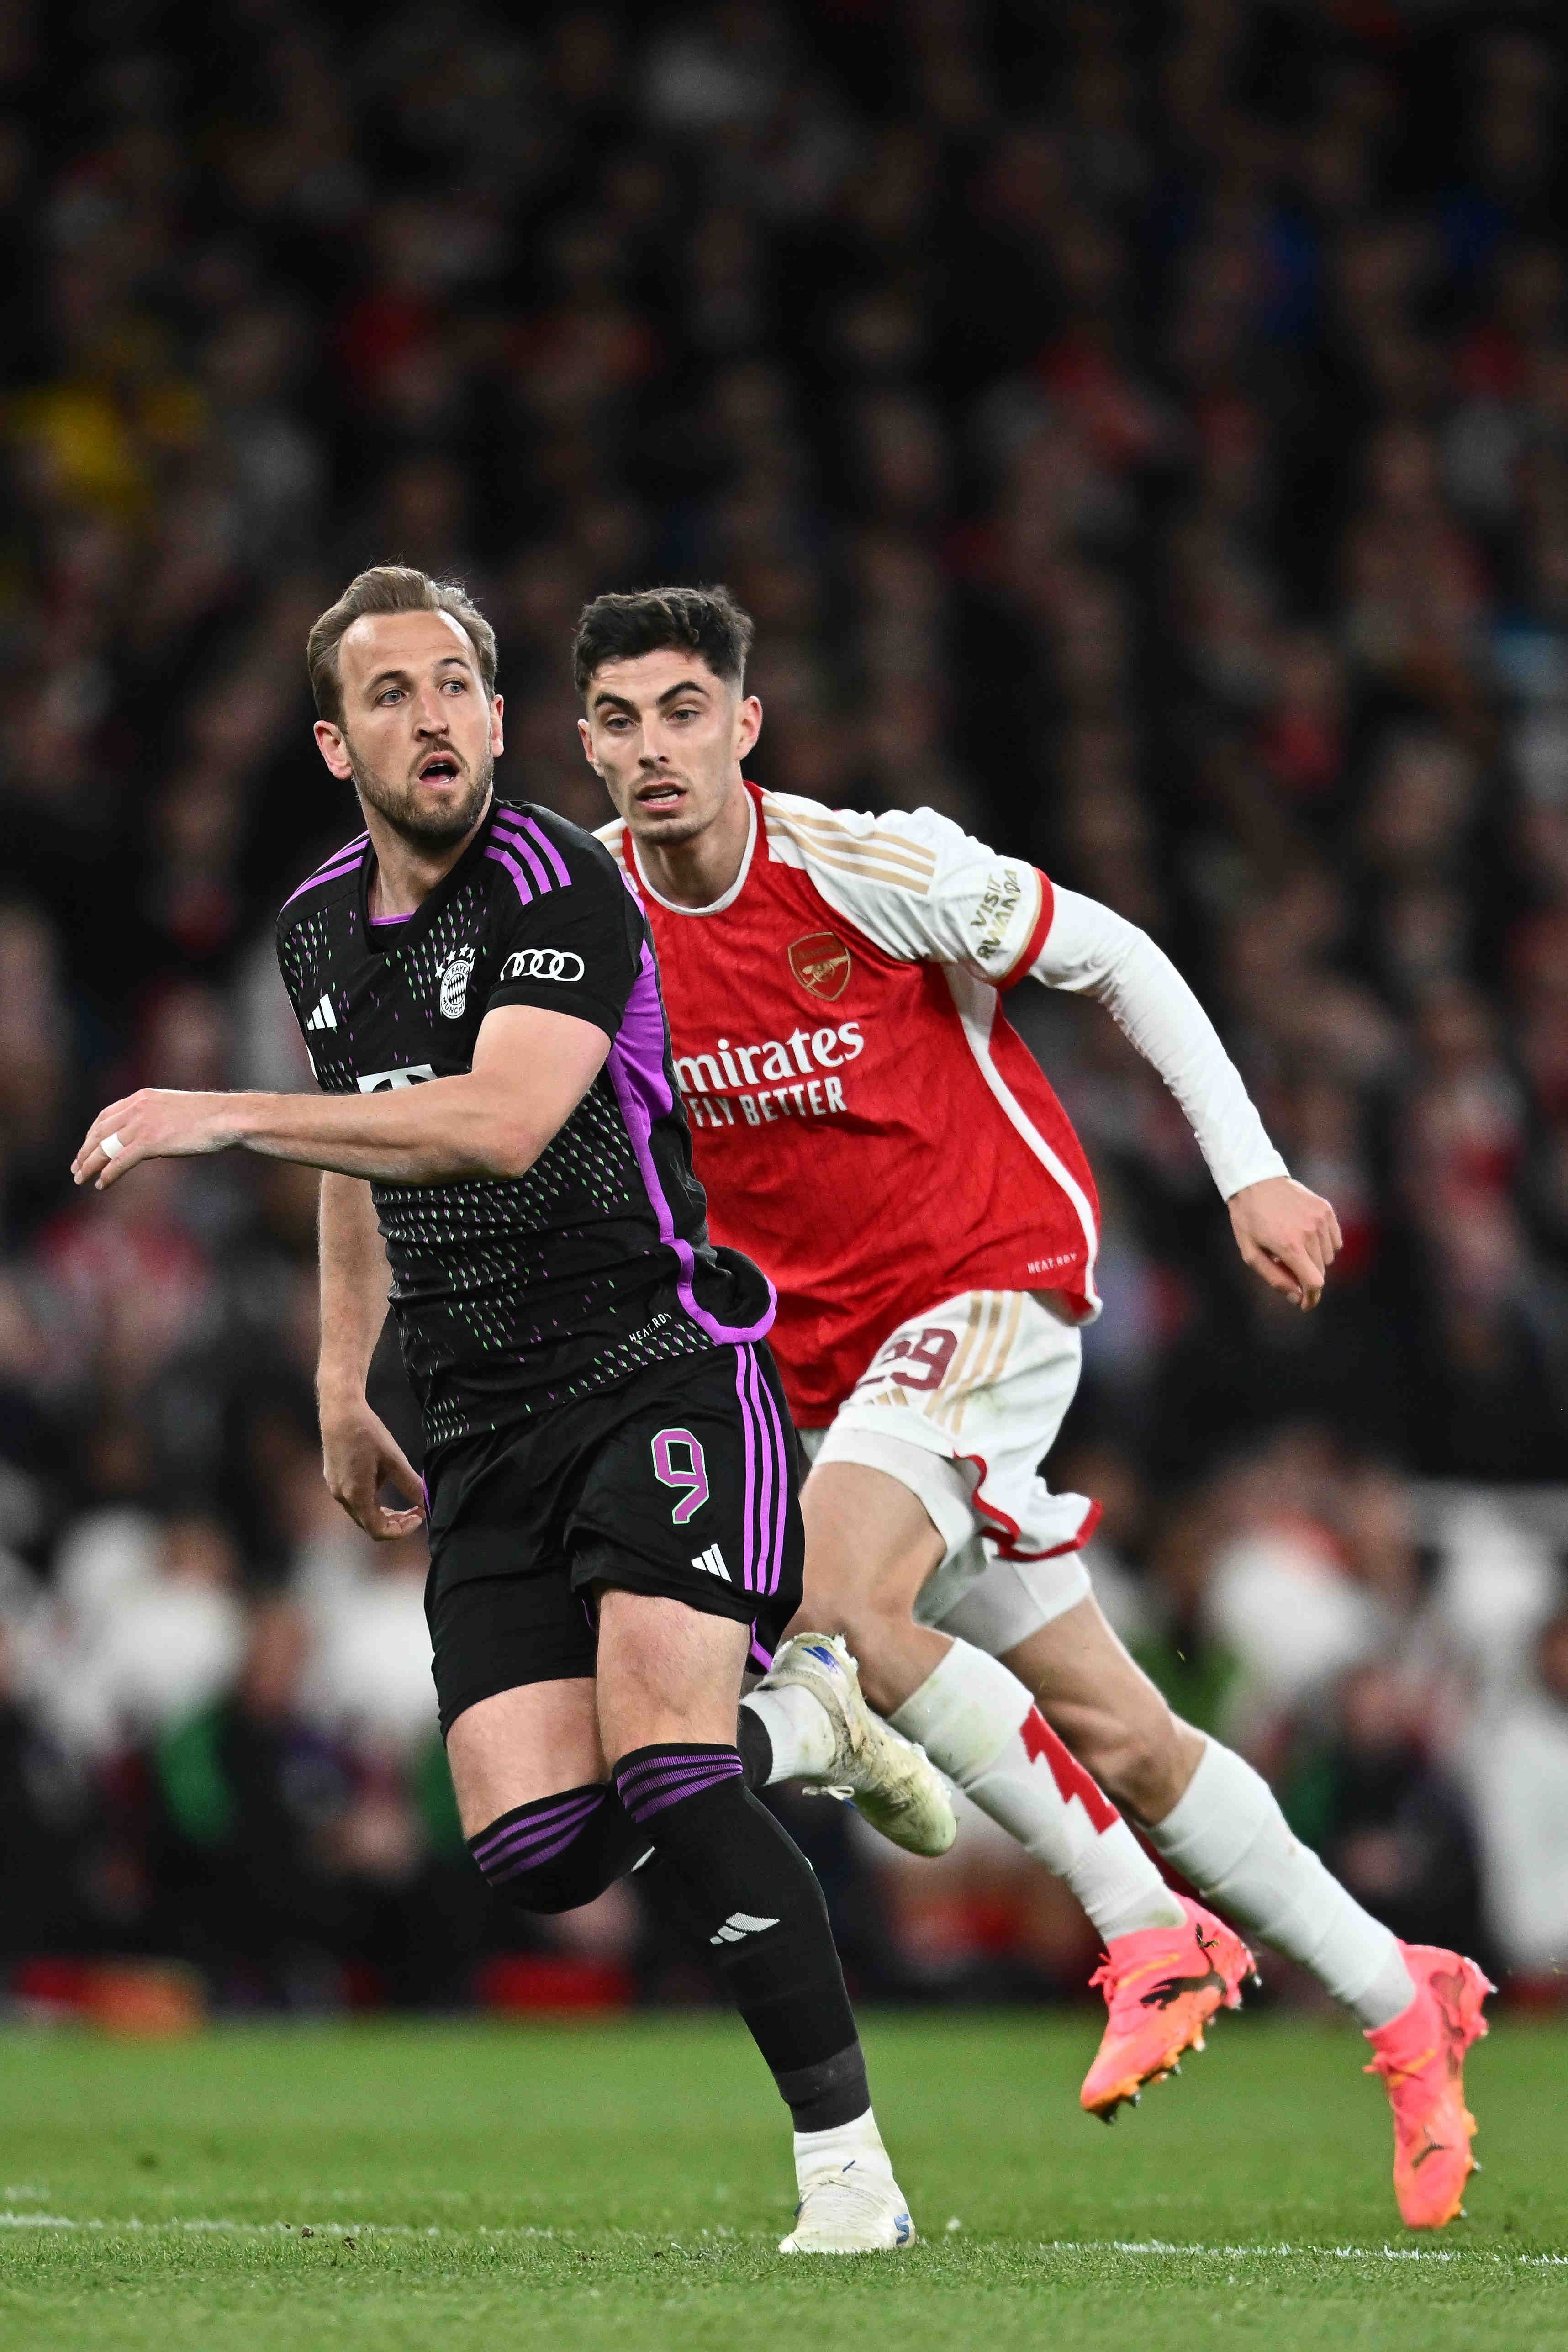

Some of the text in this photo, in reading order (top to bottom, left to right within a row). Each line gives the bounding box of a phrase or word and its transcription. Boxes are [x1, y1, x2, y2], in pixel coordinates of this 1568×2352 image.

[970, 872, 1002, 926] VISIT
[976, 869, 1021, 960] RWANDA
[672, 1022, 865, 1093] mirates
[688, 1076, 848, 1128] FLY BETTER
[629, 1312, 672, 1342] HEAT.RDY
[651, 1428, 709, 1524] 9
